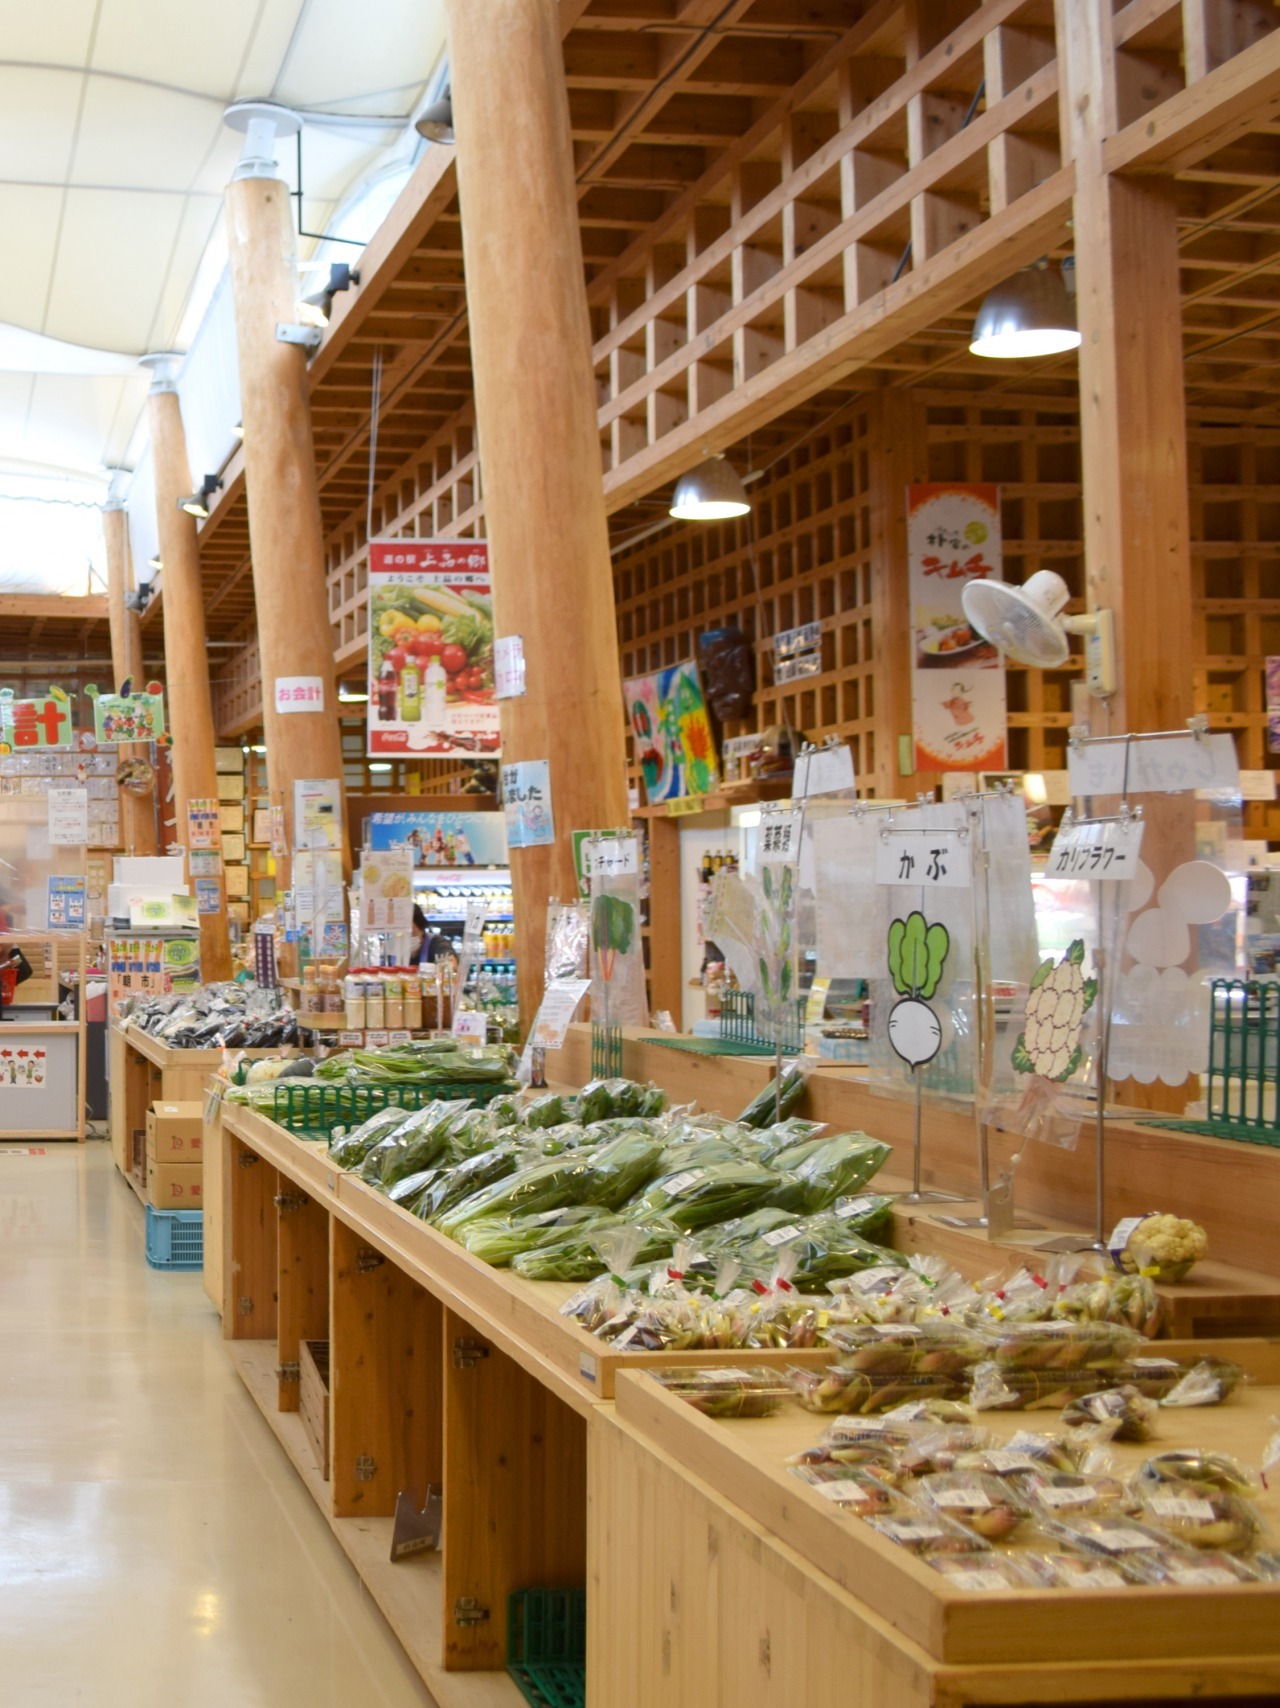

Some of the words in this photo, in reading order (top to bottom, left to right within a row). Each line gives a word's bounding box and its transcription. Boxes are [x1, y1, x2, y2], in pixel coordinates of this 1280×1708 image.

[388, 575, 424, 583] ようこそ
[921, 553, 994, 580] キムチ
[278, 685, 322, 703] お会計
[898, 847, 949, 882] かぶ
[1056, 845, 1127, 873] カリフラワー
